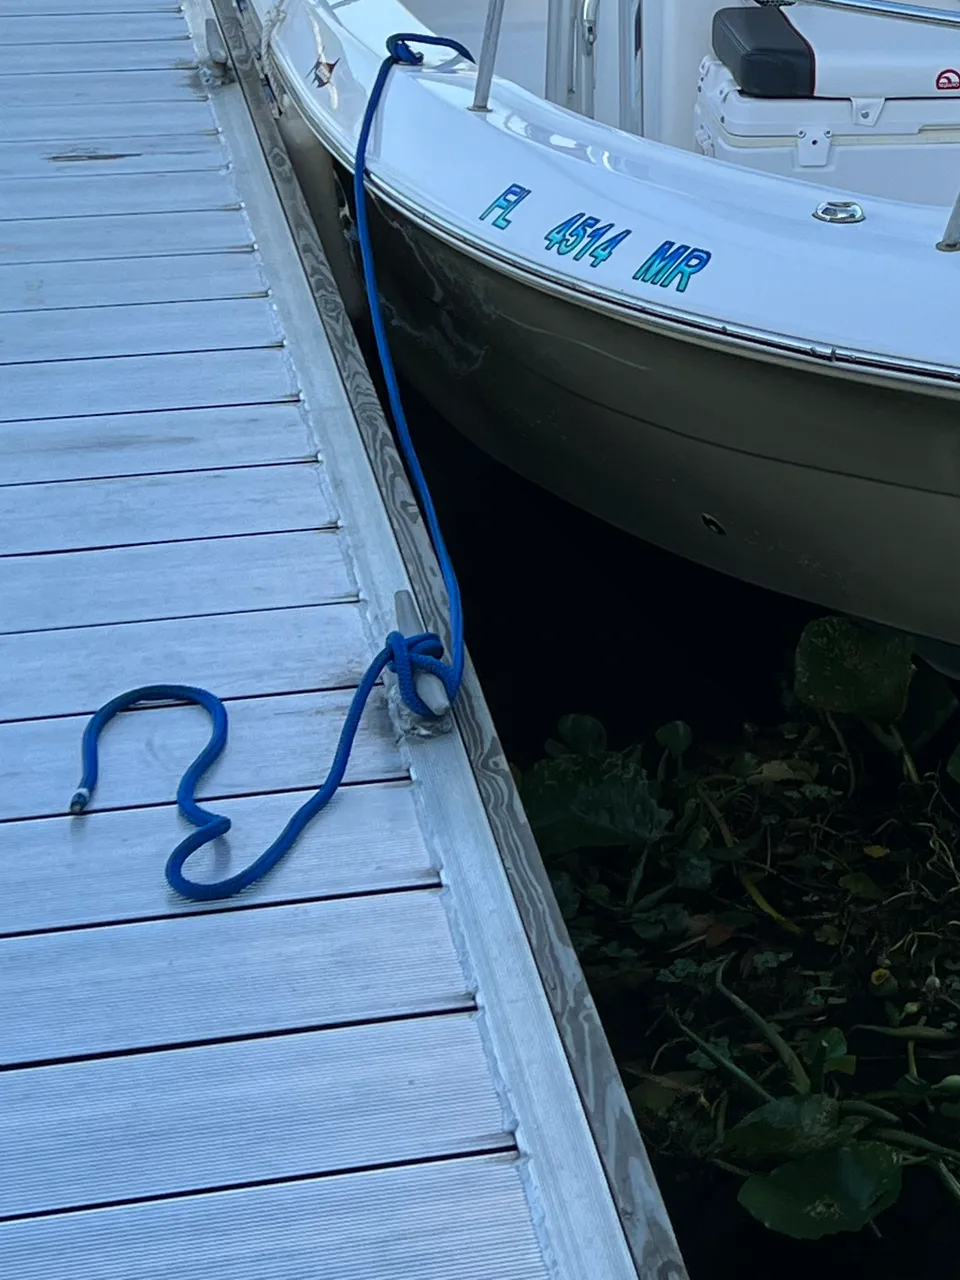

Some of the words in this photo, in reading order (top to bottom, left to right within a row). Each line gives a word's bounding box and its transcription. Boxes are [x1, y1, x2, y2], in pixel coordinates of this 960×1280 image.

[478, 183, 532, 230] FL
[544, 212, 632, 268] 4514
[632, 240, 712, 292] MR
